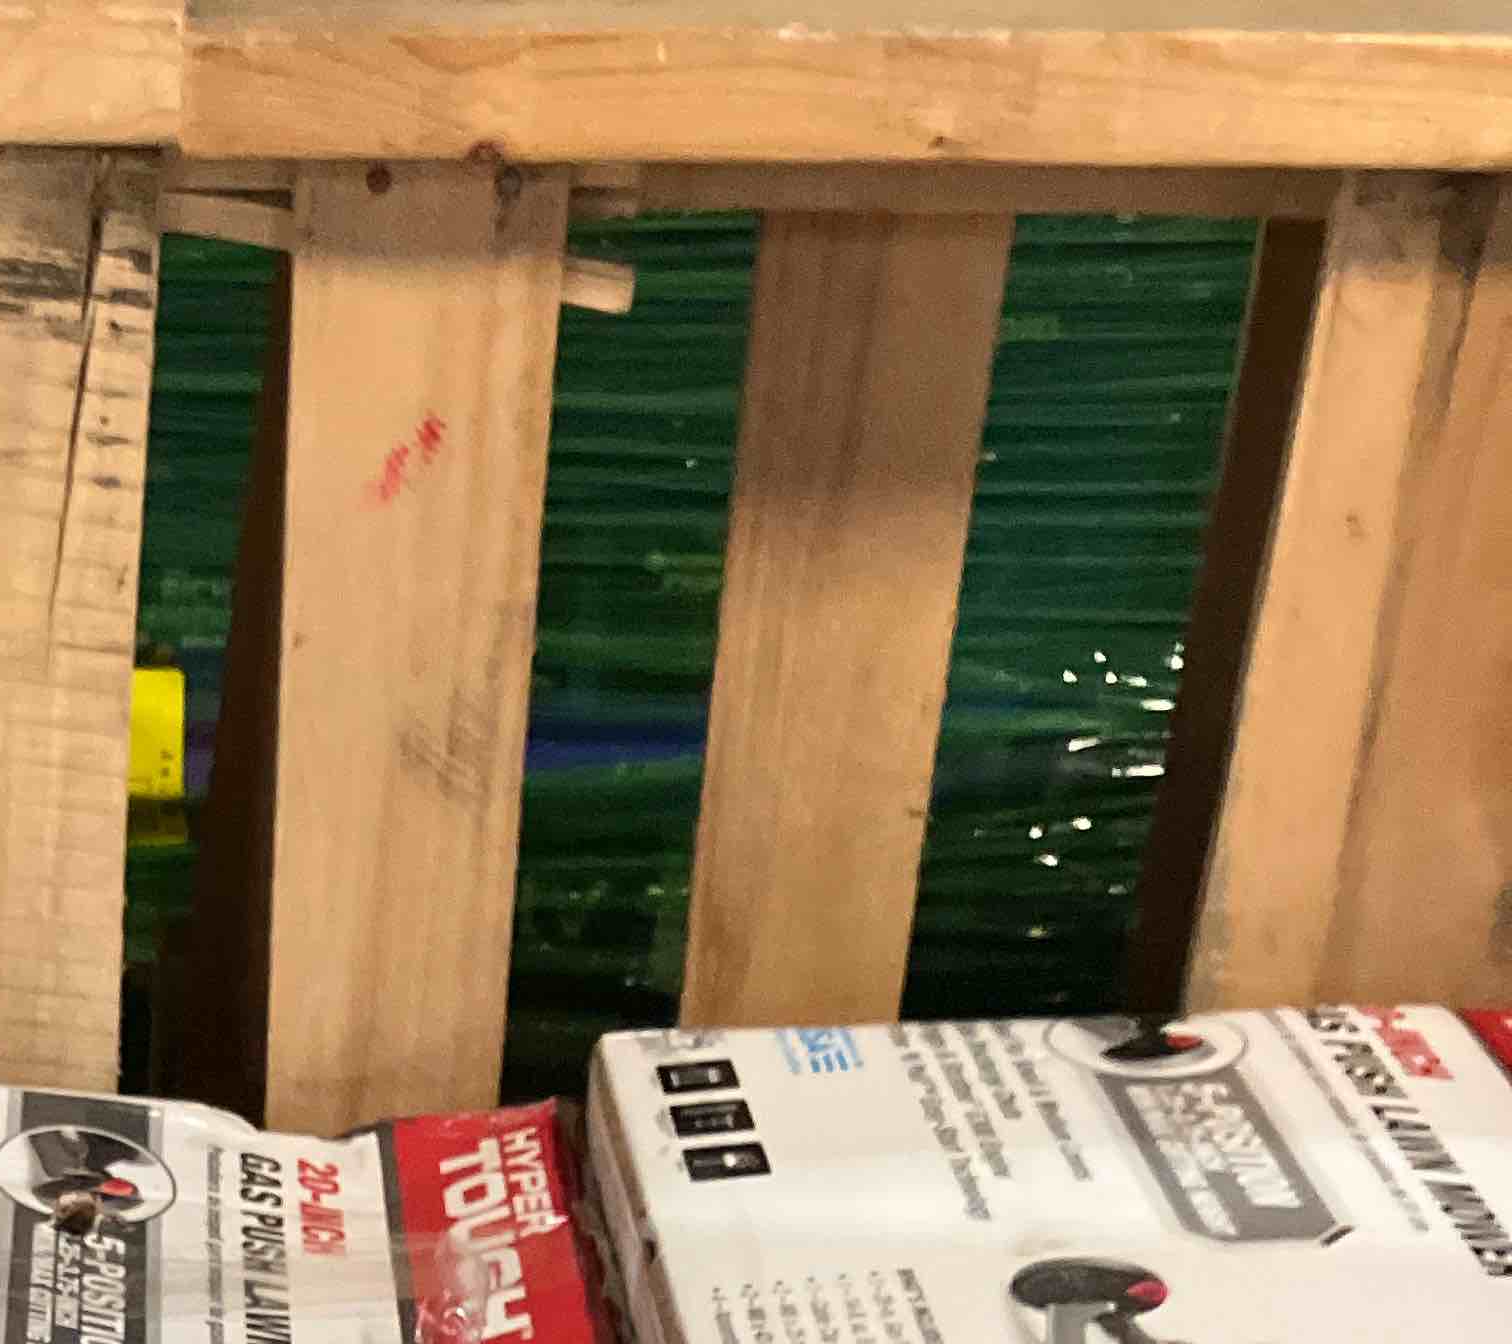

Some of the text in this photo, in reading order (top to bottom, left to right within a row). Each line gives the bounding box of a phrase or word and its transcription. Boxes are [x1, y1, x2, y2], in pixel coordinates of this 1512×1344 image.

[240, 1152, 283, 1207] GAS
[297, 1158, 347, 1256] 20-INCH
[502, 1127, 560, 1237] HYPER
[241, 1208, 289, 1277] PUSH
